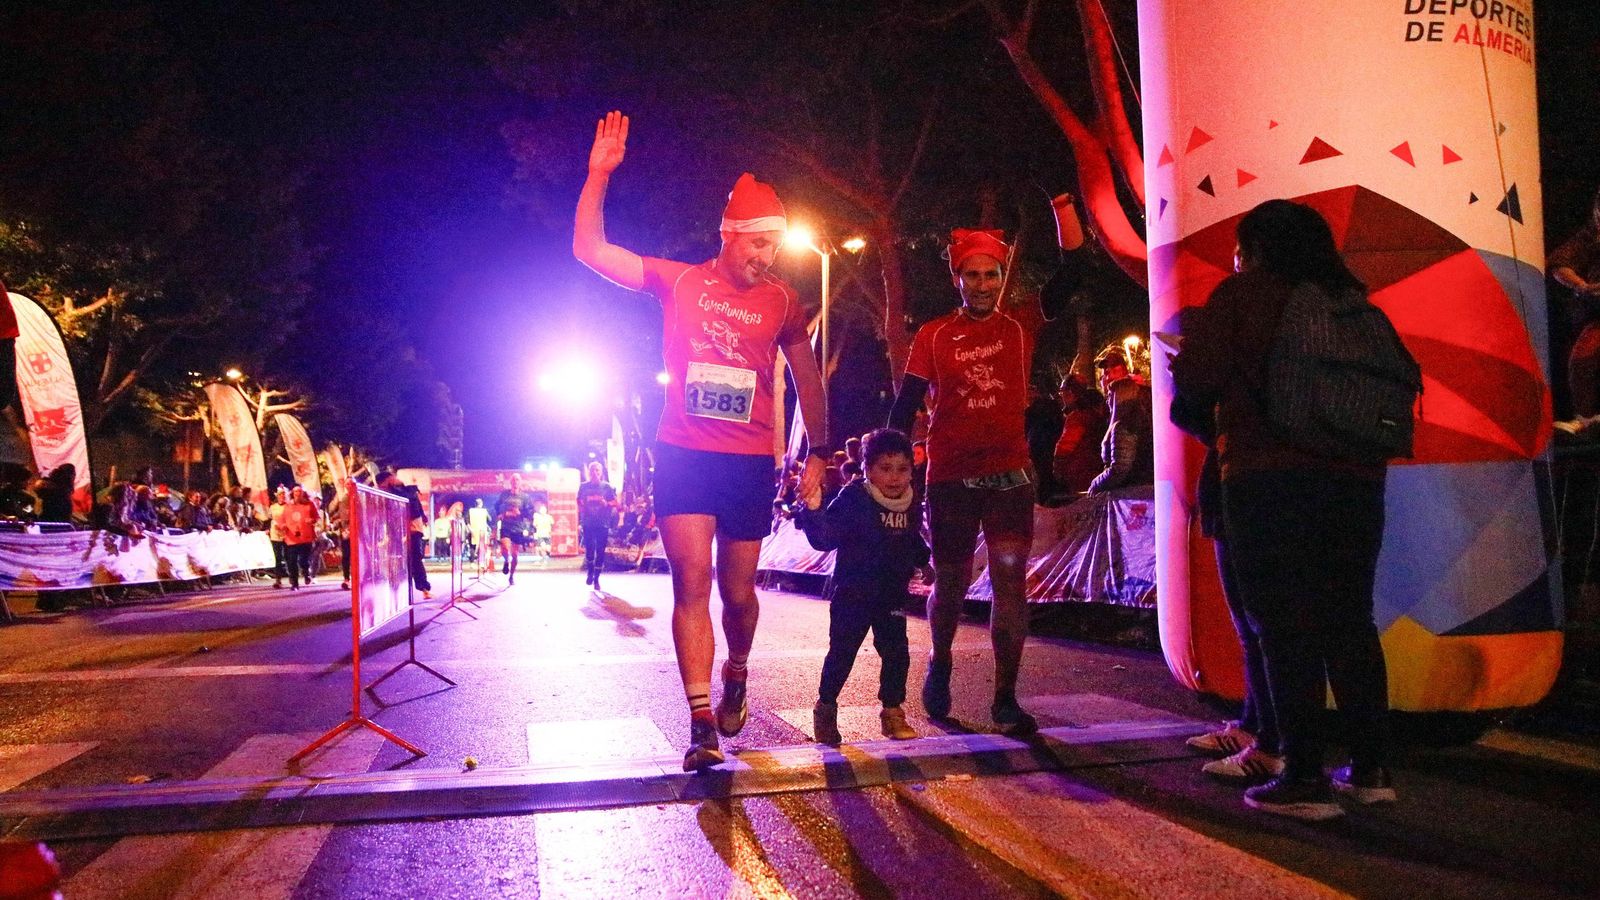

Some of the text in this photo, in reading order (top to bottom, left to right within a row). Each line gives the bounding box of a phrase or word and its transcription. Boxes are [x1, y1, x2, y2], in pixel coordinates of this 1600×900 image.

[1404, 0, 1531, 40] DEPORTES
[1404, 21, 1445, 42] DE
[698, 292, 763, 325] COMERUNNERS
[688, 388, 747, 415] 1583
